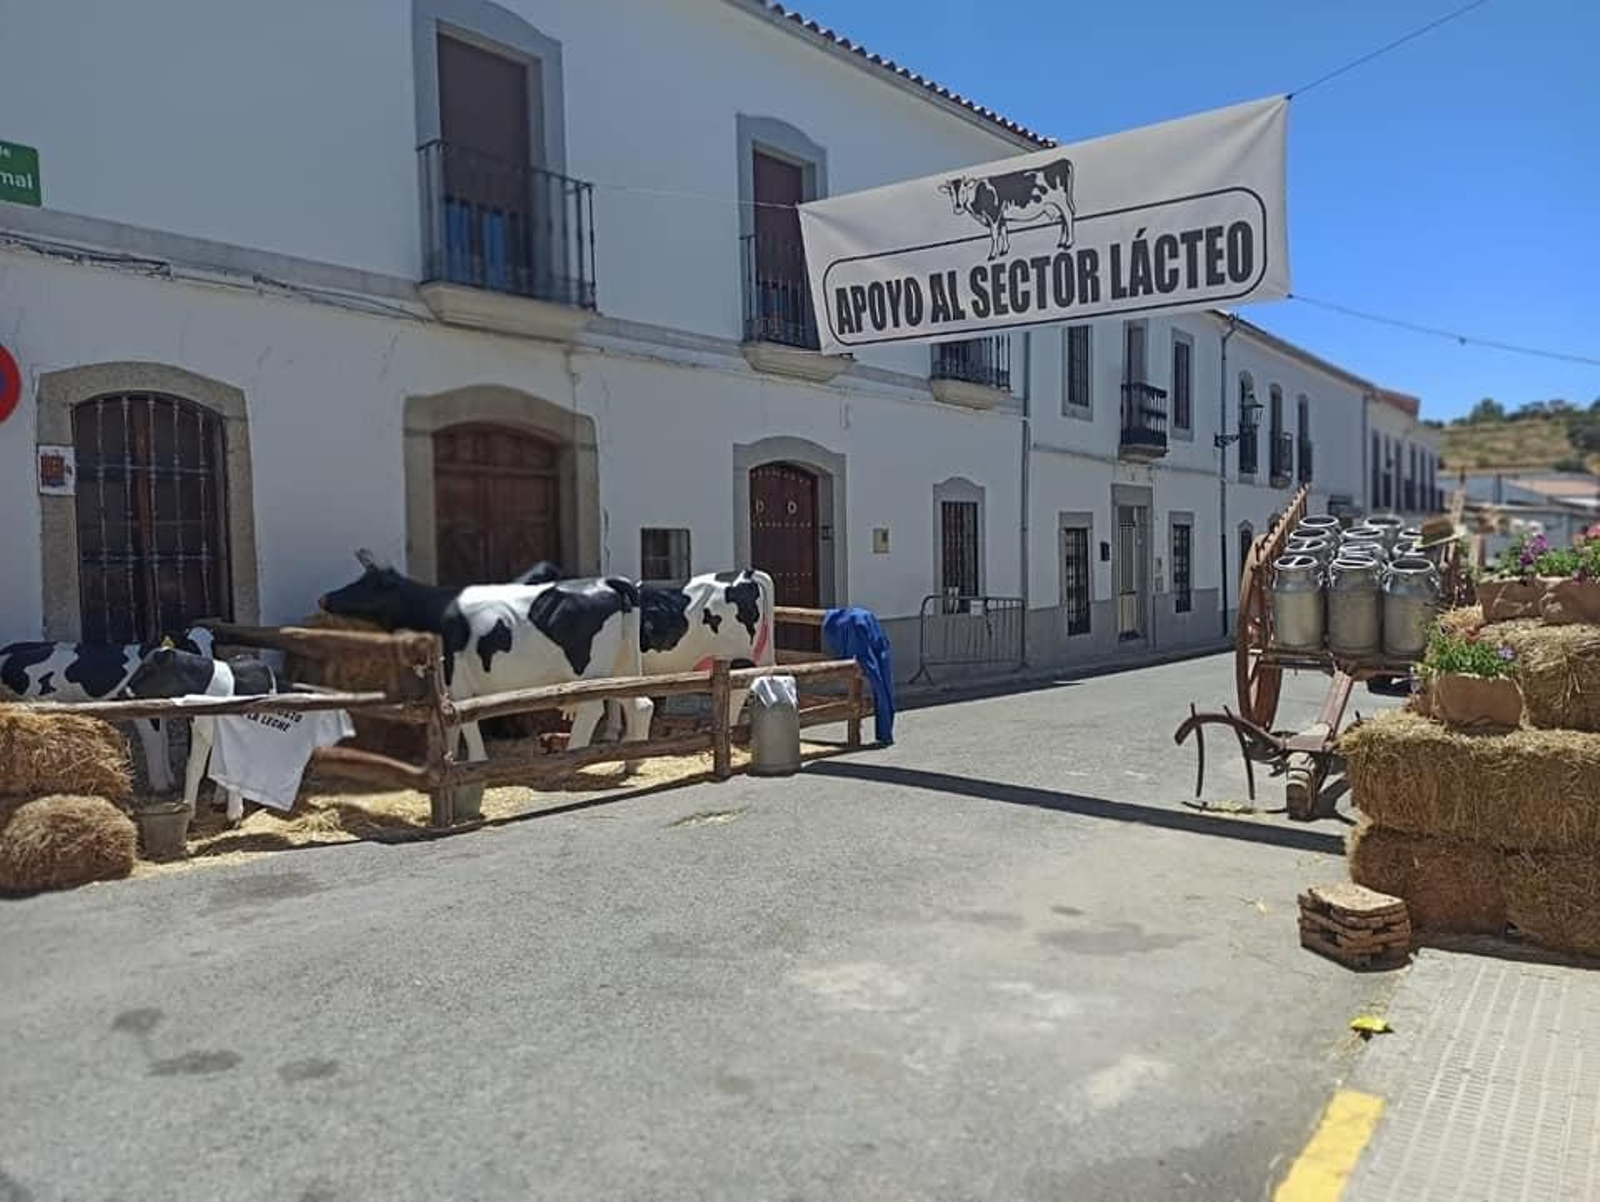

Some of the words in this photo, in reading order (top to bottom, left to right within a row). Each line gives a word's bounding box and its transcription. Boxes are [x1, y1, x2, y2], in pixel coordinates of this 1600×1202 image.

[835, 277, 923, 335] APOYO
[929, 270, 966, 323] AL
[969, 248, 1100, 318] SECTOR
[1110, 220, 1254, 300] LÁCTEO
[260, 715, 291, 732] LECHE
